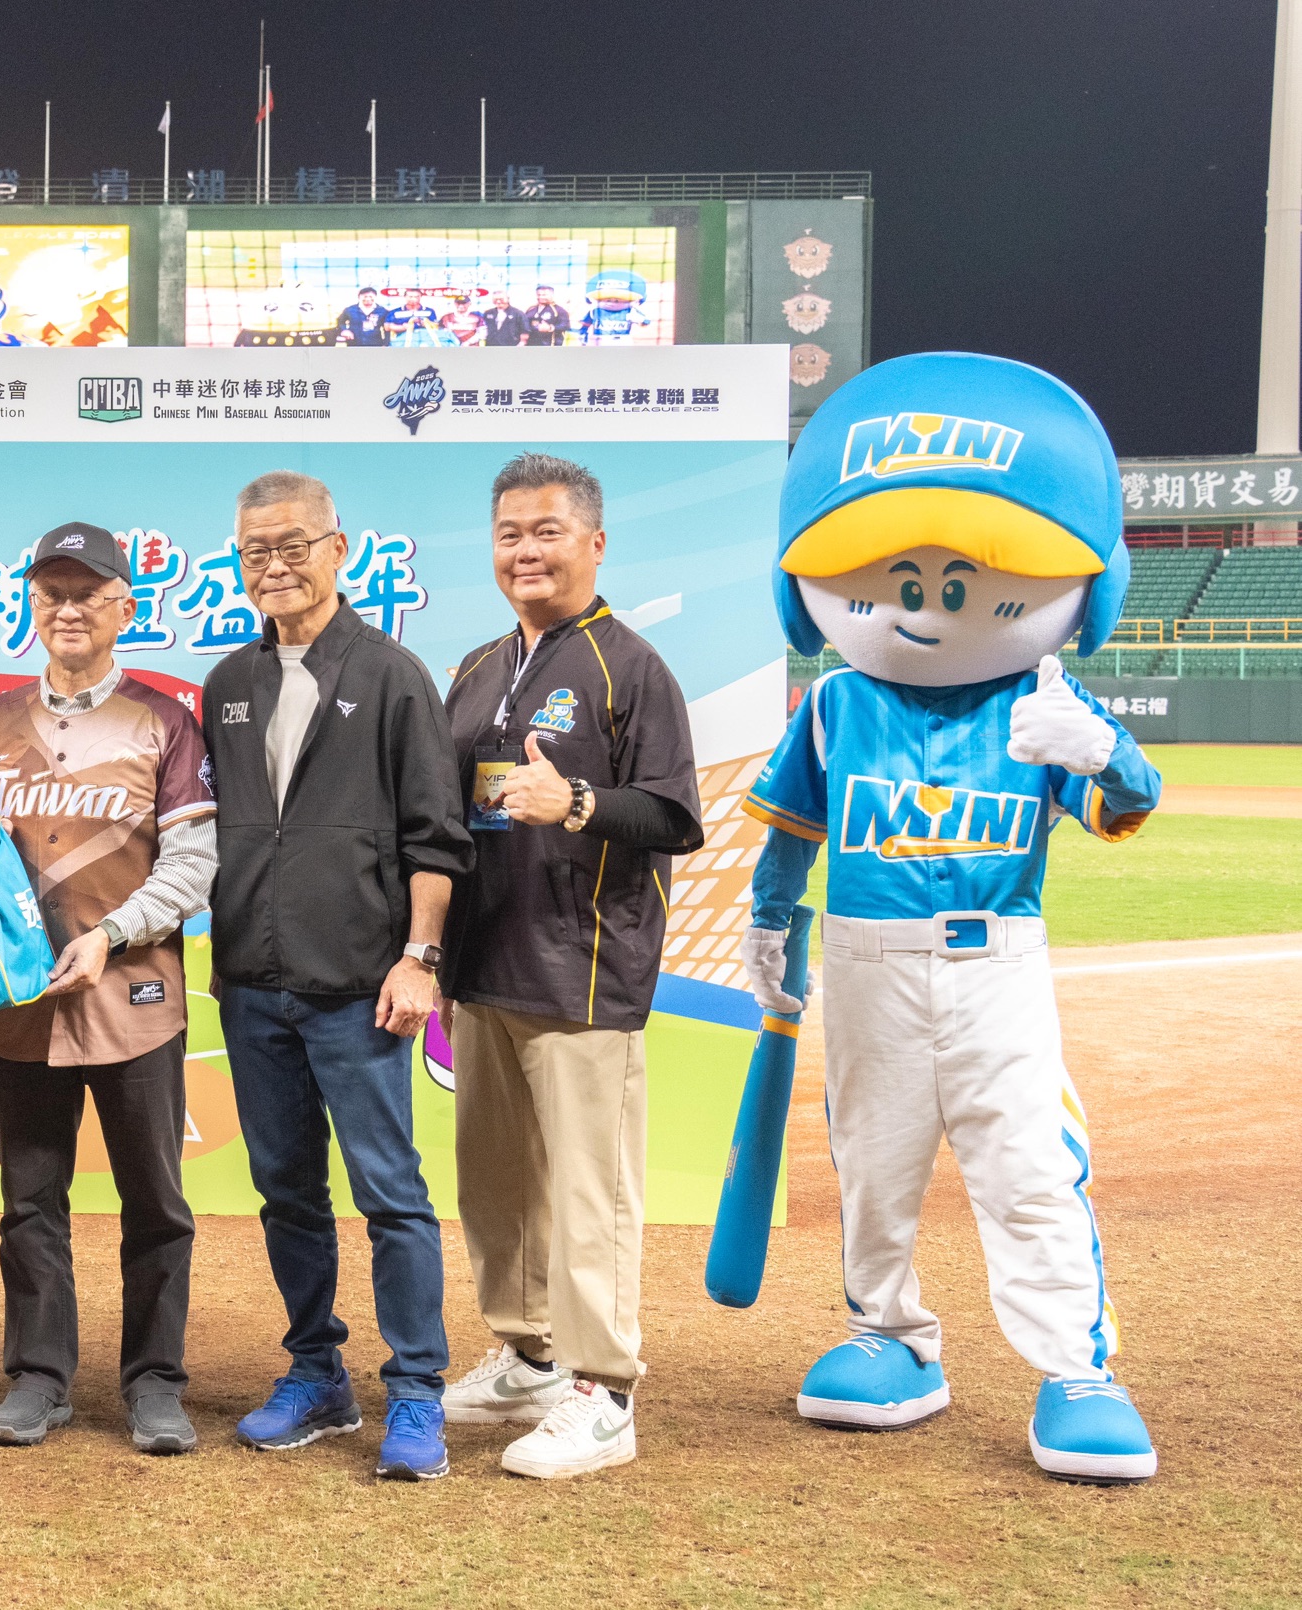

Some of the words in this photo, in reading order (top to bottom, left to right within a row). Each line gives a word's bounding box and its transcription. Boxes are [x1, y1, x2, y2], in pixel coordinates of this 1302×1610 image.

[415, 373, 435, 382] 2025
[153, 379, 331, 399] 中華迷你棒球協會
[451, 388, 720, 406] 亞洲冬季棒球聯盟
[840, 412, 1024, 484] MINI
[222, 701, 250, 724] CPBL
[529, 709, 576, 733] MINI
[537, 730, 556, 740] WBSC
[483, 774, 507, 782] VIP
[840, 774, 1042, 862] MINI
